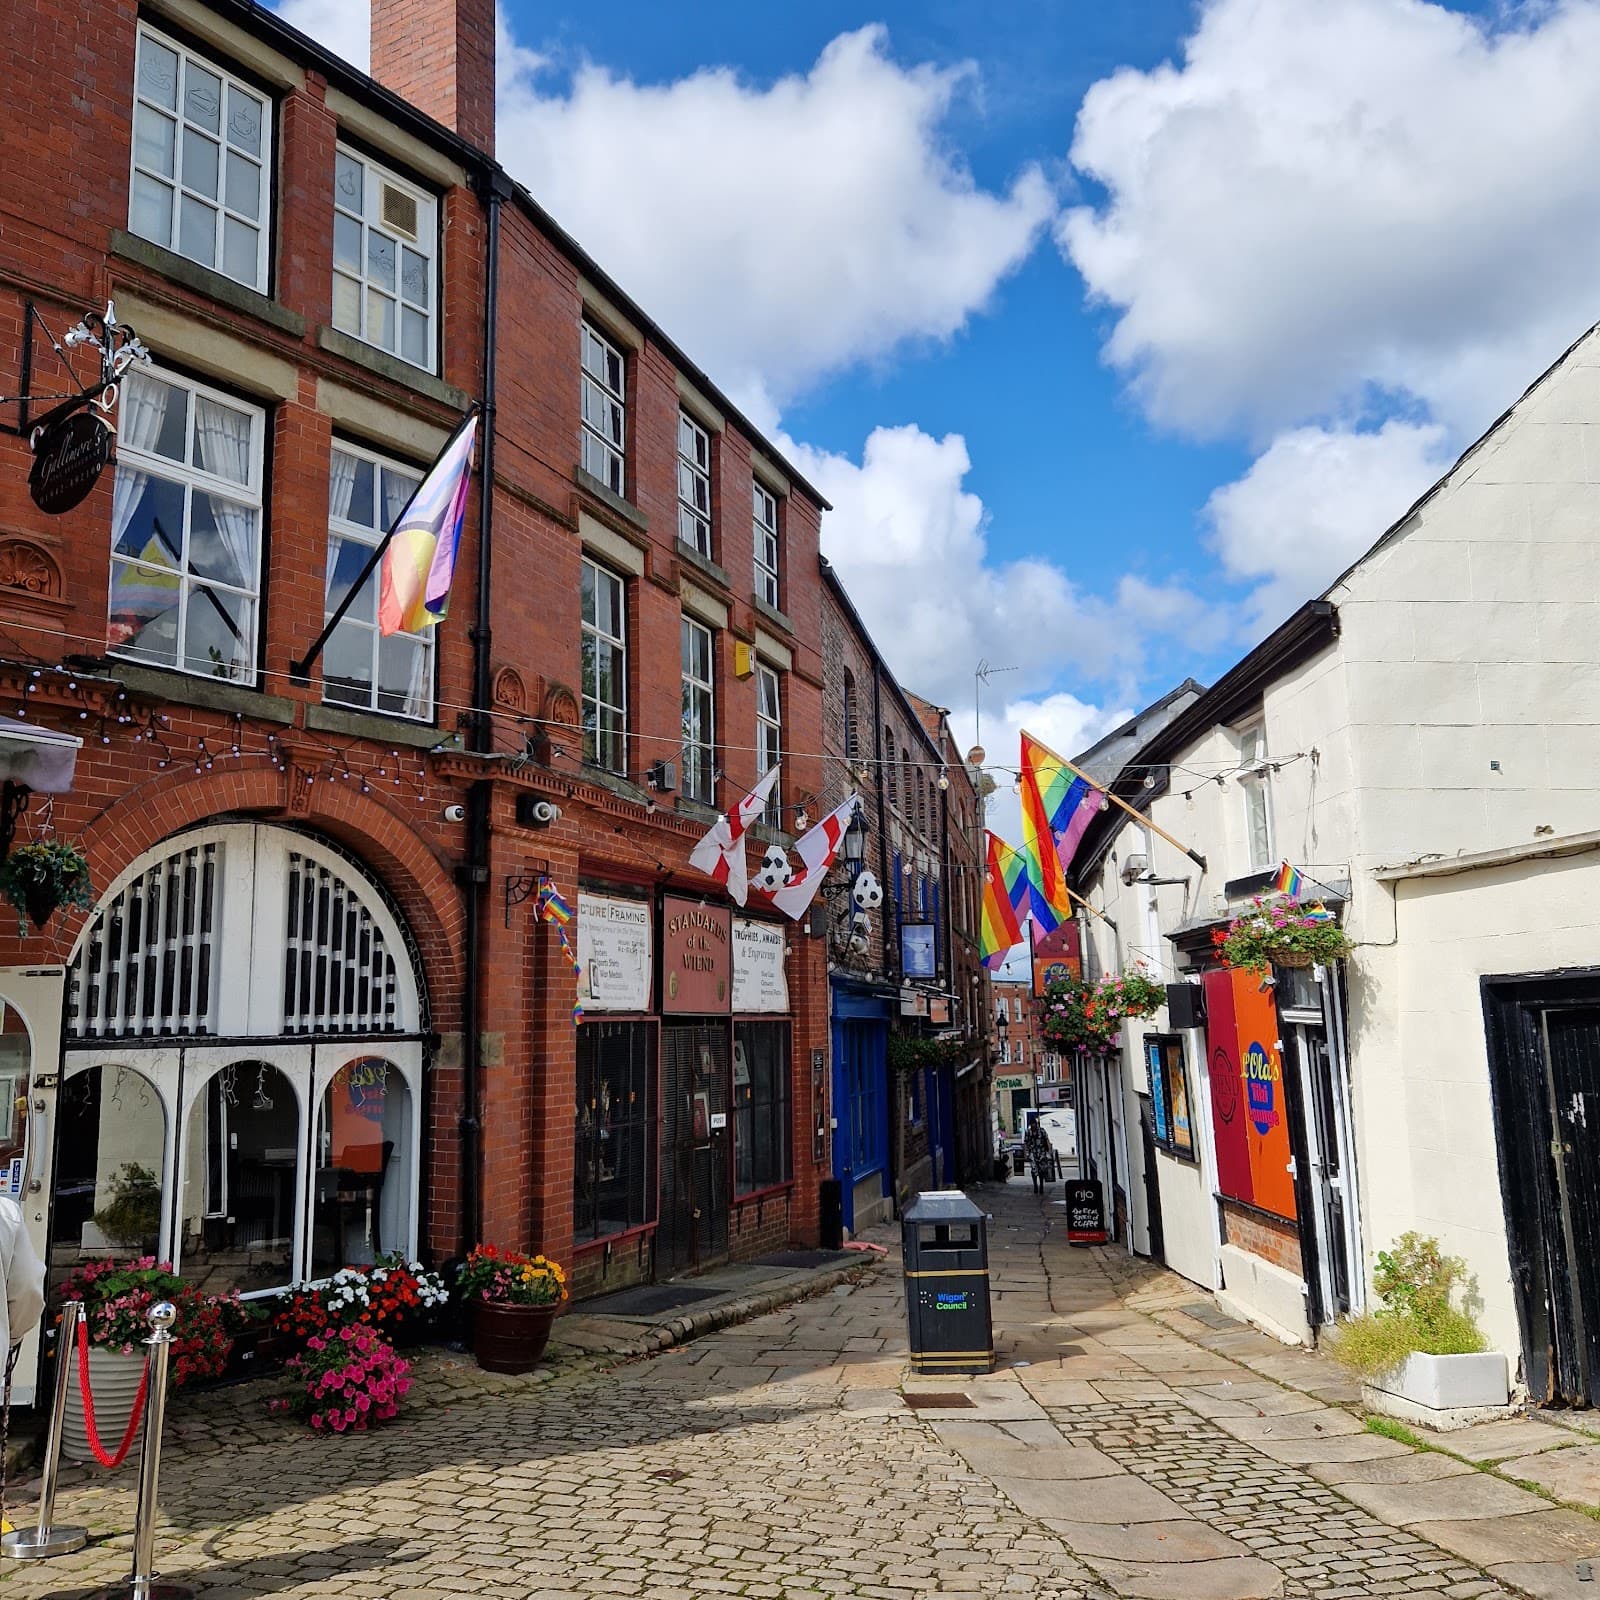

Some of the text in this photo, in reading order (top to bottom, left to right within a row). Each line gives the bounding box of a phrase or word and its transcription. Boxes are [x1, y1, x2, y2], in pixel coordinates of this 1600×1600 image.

[610, 907, 646, 923] FRAMING
[669, 911, 727, 944] STANDARDS
[687, 933, 711, 951] of the
[683, 953, 714, 972] WIEND
[1250, 1082, 1268, 1103] Tiki
[936, 1302, 967, 1310] Council
[937, 1293, 965, 1303] Wigan
